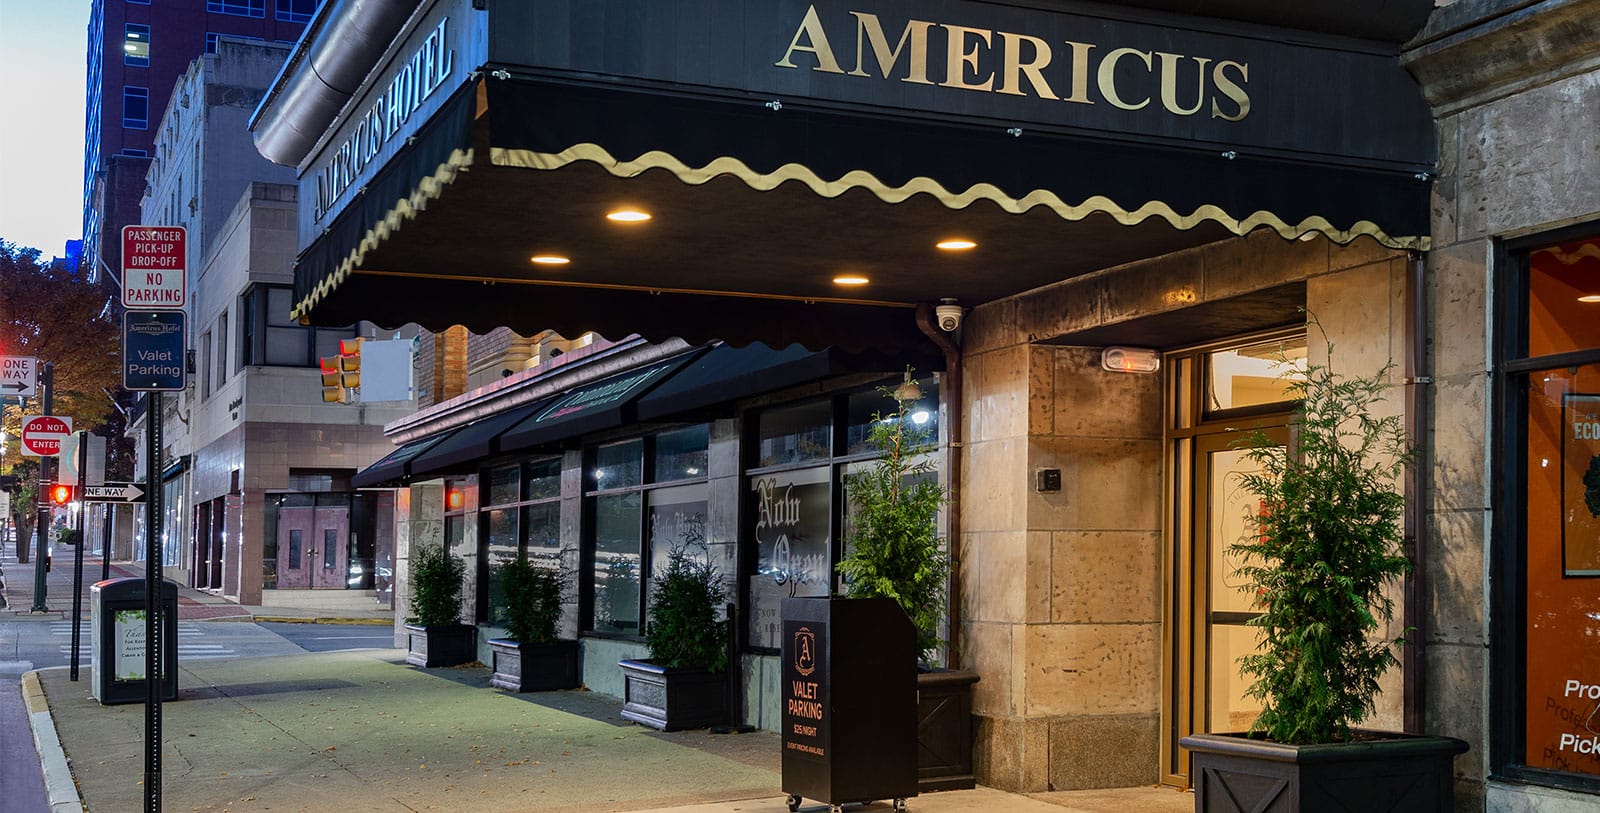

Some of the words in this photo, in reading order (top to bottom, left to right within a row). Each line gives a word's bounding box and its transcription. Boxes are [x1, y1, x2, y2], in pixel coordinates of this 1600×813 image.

[774, 4, 1251, 122] AMERICUS
[314, 94, 386, 225] AMERICUS
[384, 16, 452, 143] HOTEL
[128, 230, 181, 241] PASSENGER
[135, 243, 174, 253] PICK-UP
[131, 256, 177, 266] DROP-OFF
[146, 272, 163, 285] NO
[128, 288, 181, 302] PARKING
[128, 323, 161, 333] Americus
[162, 323, 181, 333] Hotel
[137, 350, 172, 361] Valet
[3, 359, 28, 369] ONE
[2, 370, 29, 379] WAY
[128, 364, 181, 378] Parking
[30, 423, 42, 431] DO
[47, 423, 64, 431] NOT
[32, 440, 60, 449] ENTER
[85, 487, 101, 496] NE
[104, 488, 125, 496] WAY
[756, 477, 800, 543] Now
[773, 533, 829, 598] Open
[792, 680, 818, 700] VALET
[1564, 679, 1600, 699] Pro
[788, 699, 823, 720] PARKING
[1559, 733, 1600, 754] Pick
